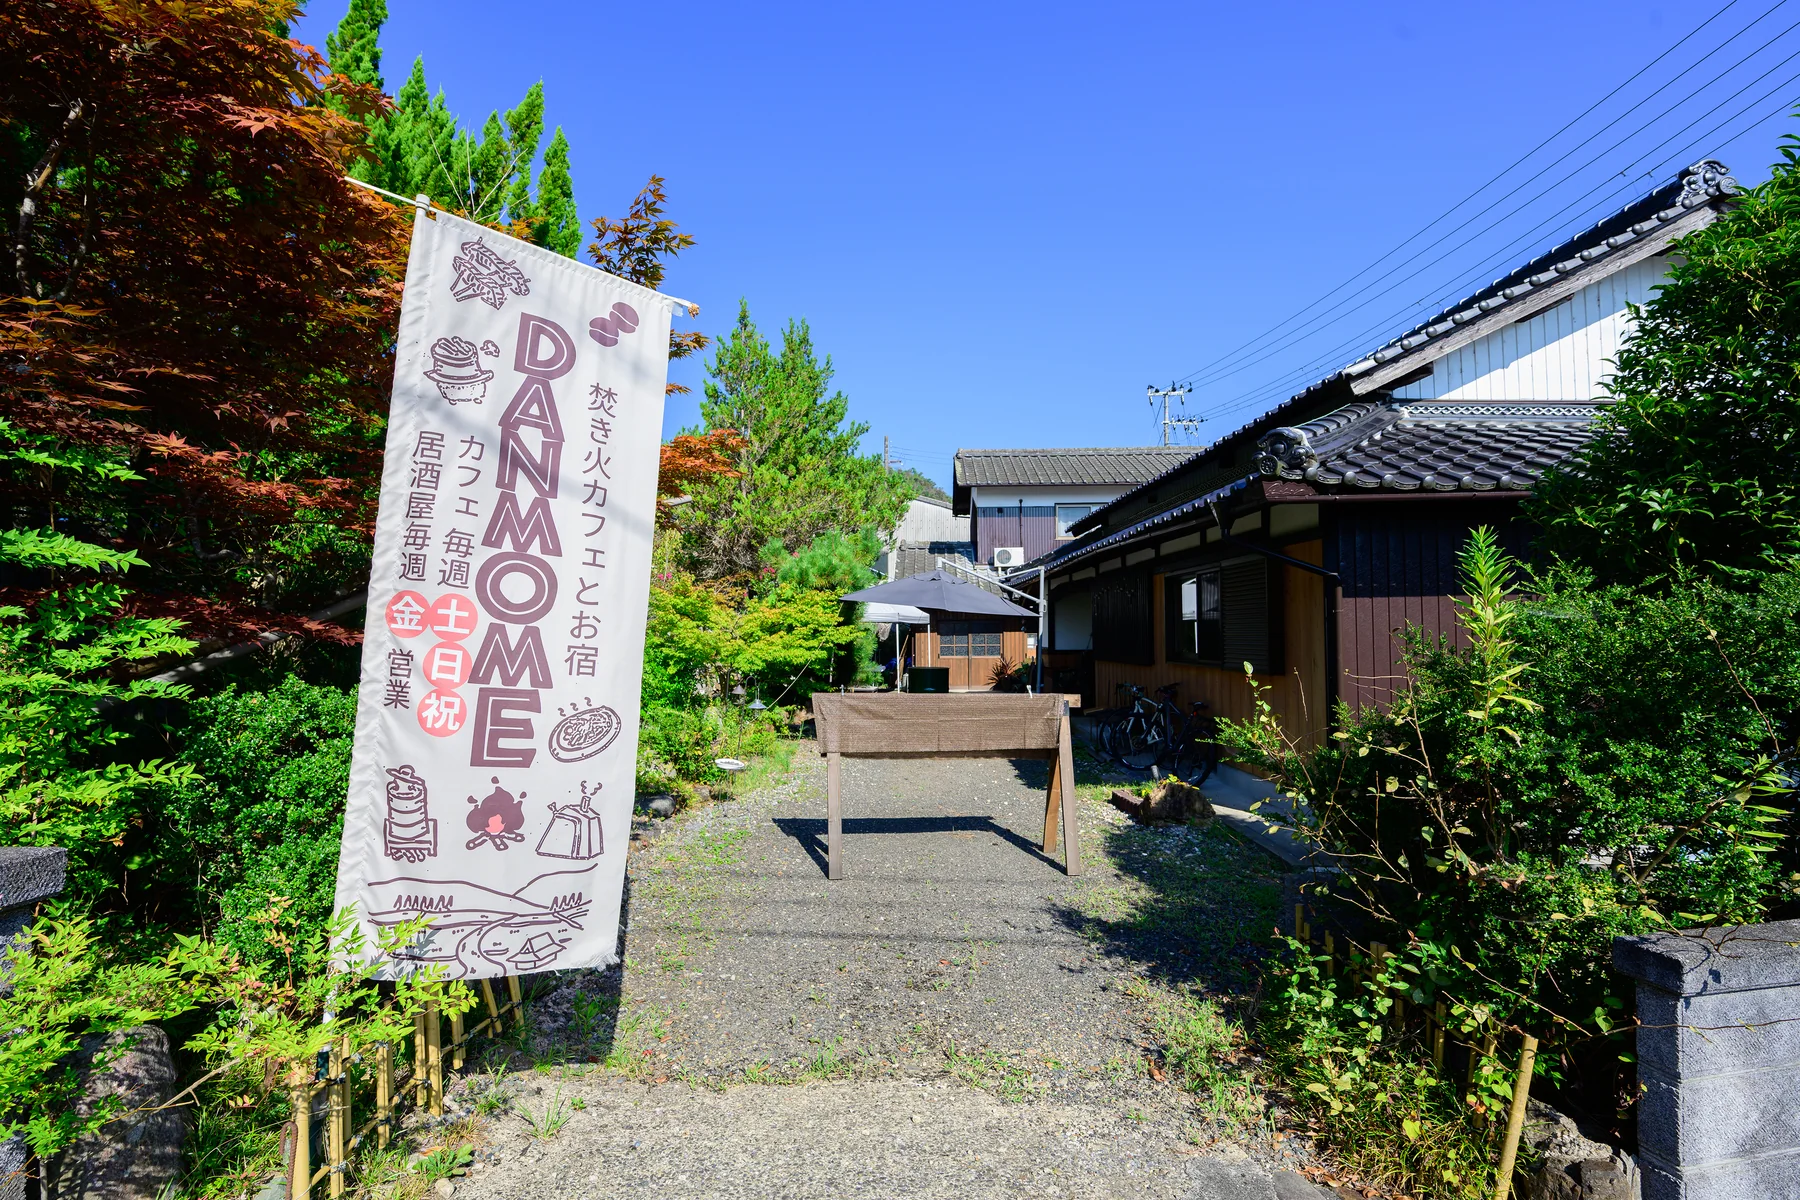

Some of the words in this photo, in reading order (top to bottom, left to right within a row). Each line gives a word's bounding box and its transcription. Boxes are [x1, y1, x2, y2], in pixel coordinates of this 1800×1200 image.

[467, 312, 577, 768] DANMOME
[564, 382, 618, 677] 焚き火カフェとお宿
[383, 648, 414, 710] 営業
